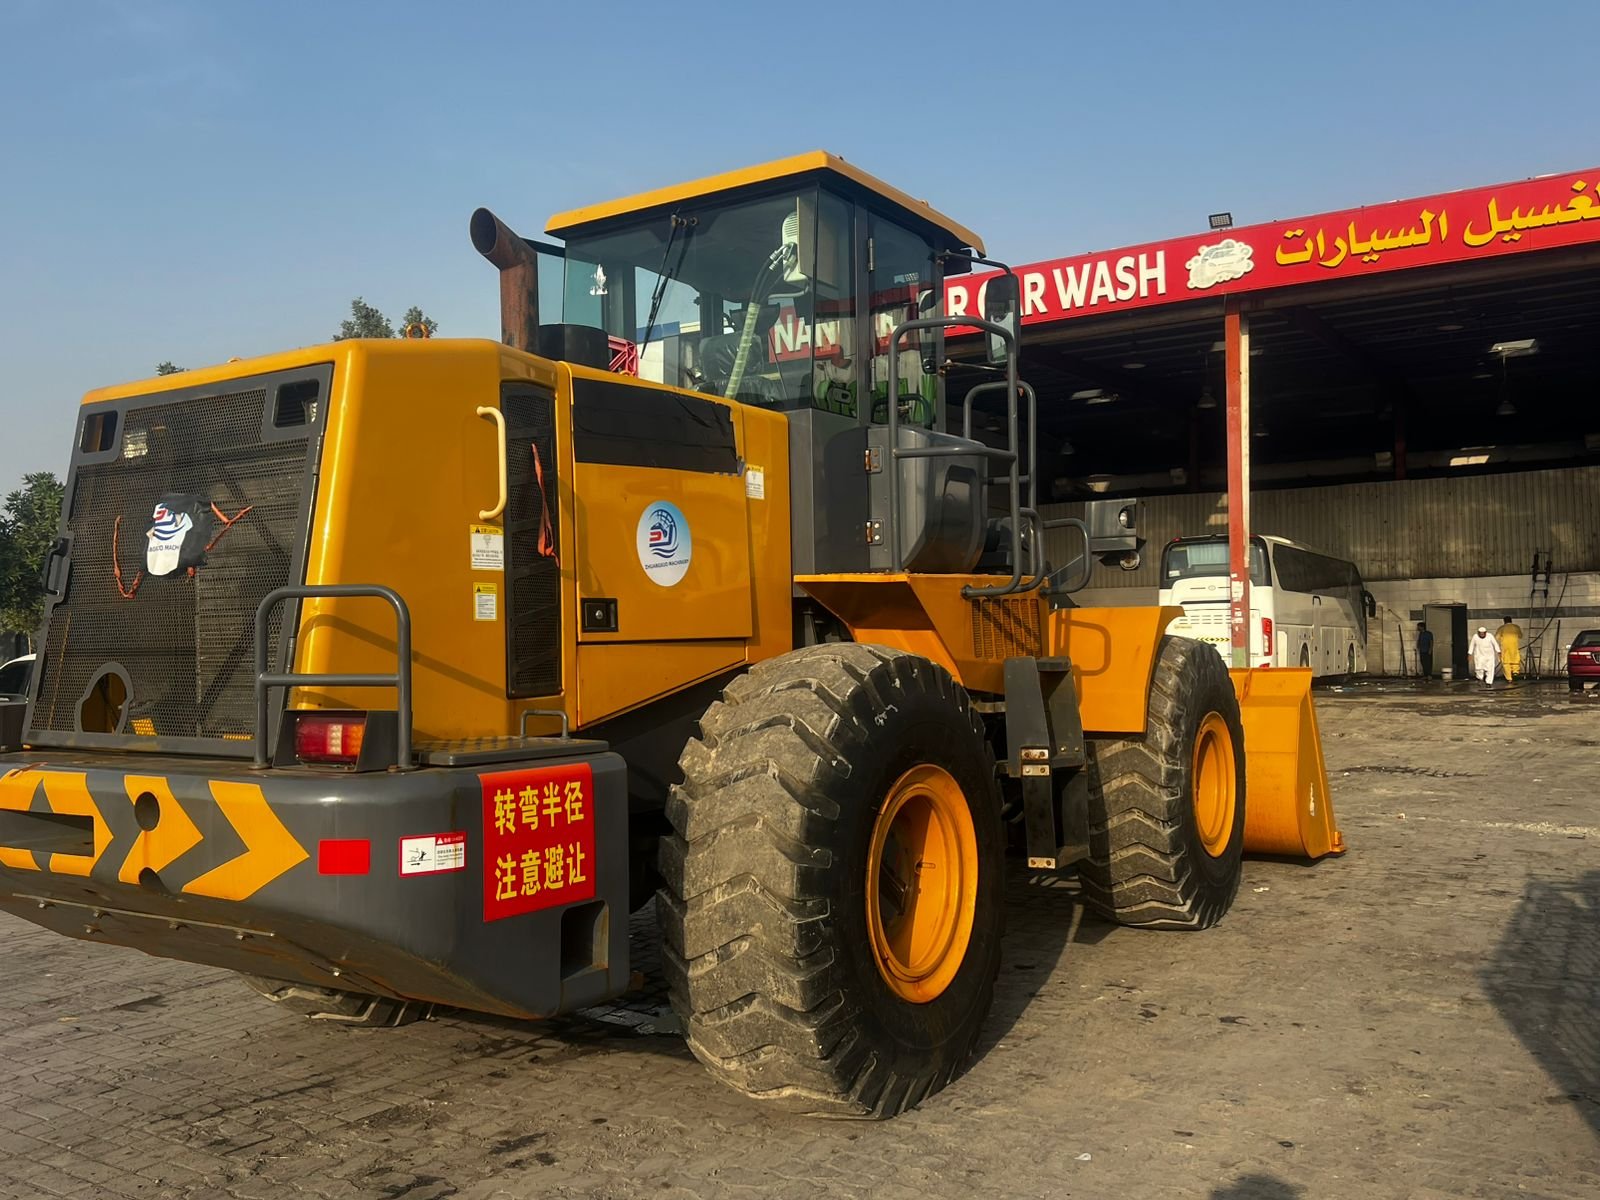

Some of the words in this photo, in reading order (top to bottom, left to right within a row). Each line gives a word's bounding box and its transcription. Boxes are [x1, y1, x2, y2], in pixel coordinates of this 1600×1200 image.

[1275, 209, 1447, 268] السيارات
[1052, 250, 1167, 310] WASH
[494, 780, 585, 835] 转弯半径
[495, 841, 586, 901] 注意避让
